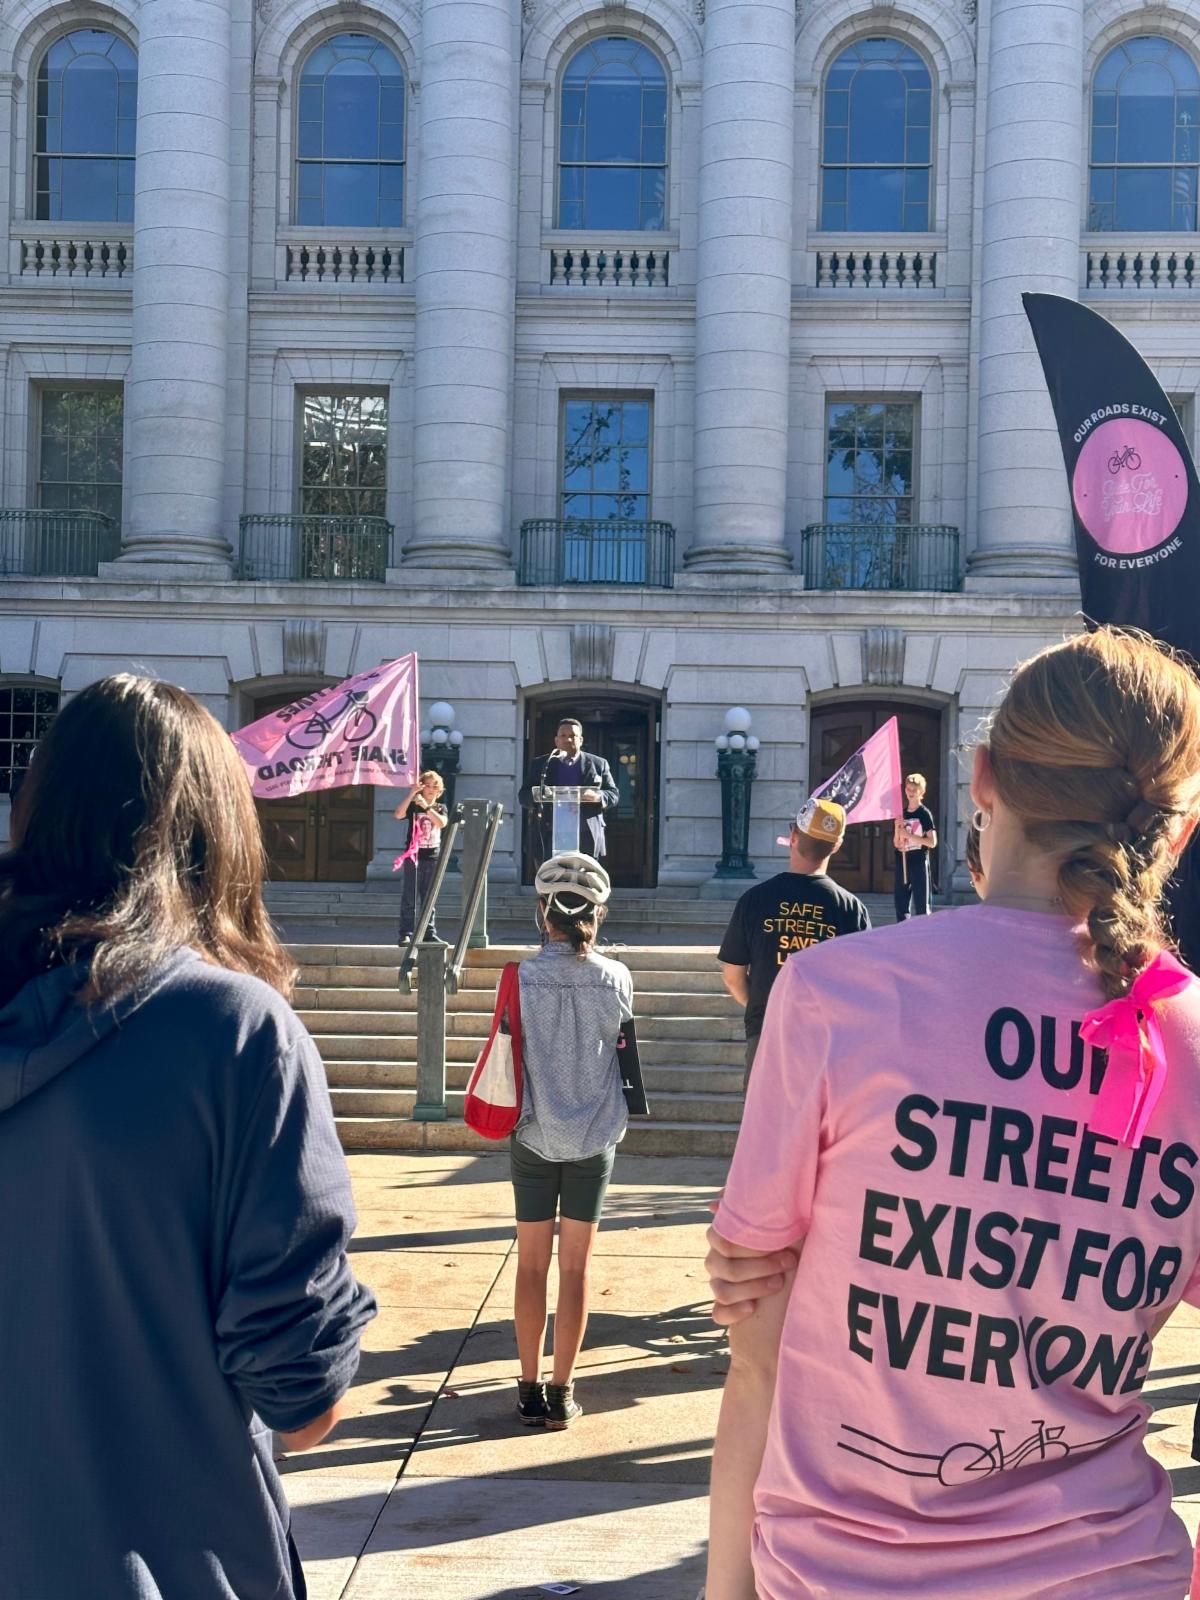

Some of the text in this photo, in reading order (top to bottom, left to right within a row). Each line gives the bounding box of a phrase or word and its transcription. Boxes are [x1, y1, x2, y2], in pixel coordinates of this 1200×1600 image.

[1073, 404, 1168, 443] OUR ROADS EXIST
[1094, 536, 1183, 569] FOR EVERYONE
[763, 919, 837, 939] STREETS
[779, 901, 825, 920] SAFE
[890, 1093, 1199, 1220] STREETS
[859, 1187, 1182, 1313] EXIST FOR
[847, 1282, 1152, 1396] EVERYONE
